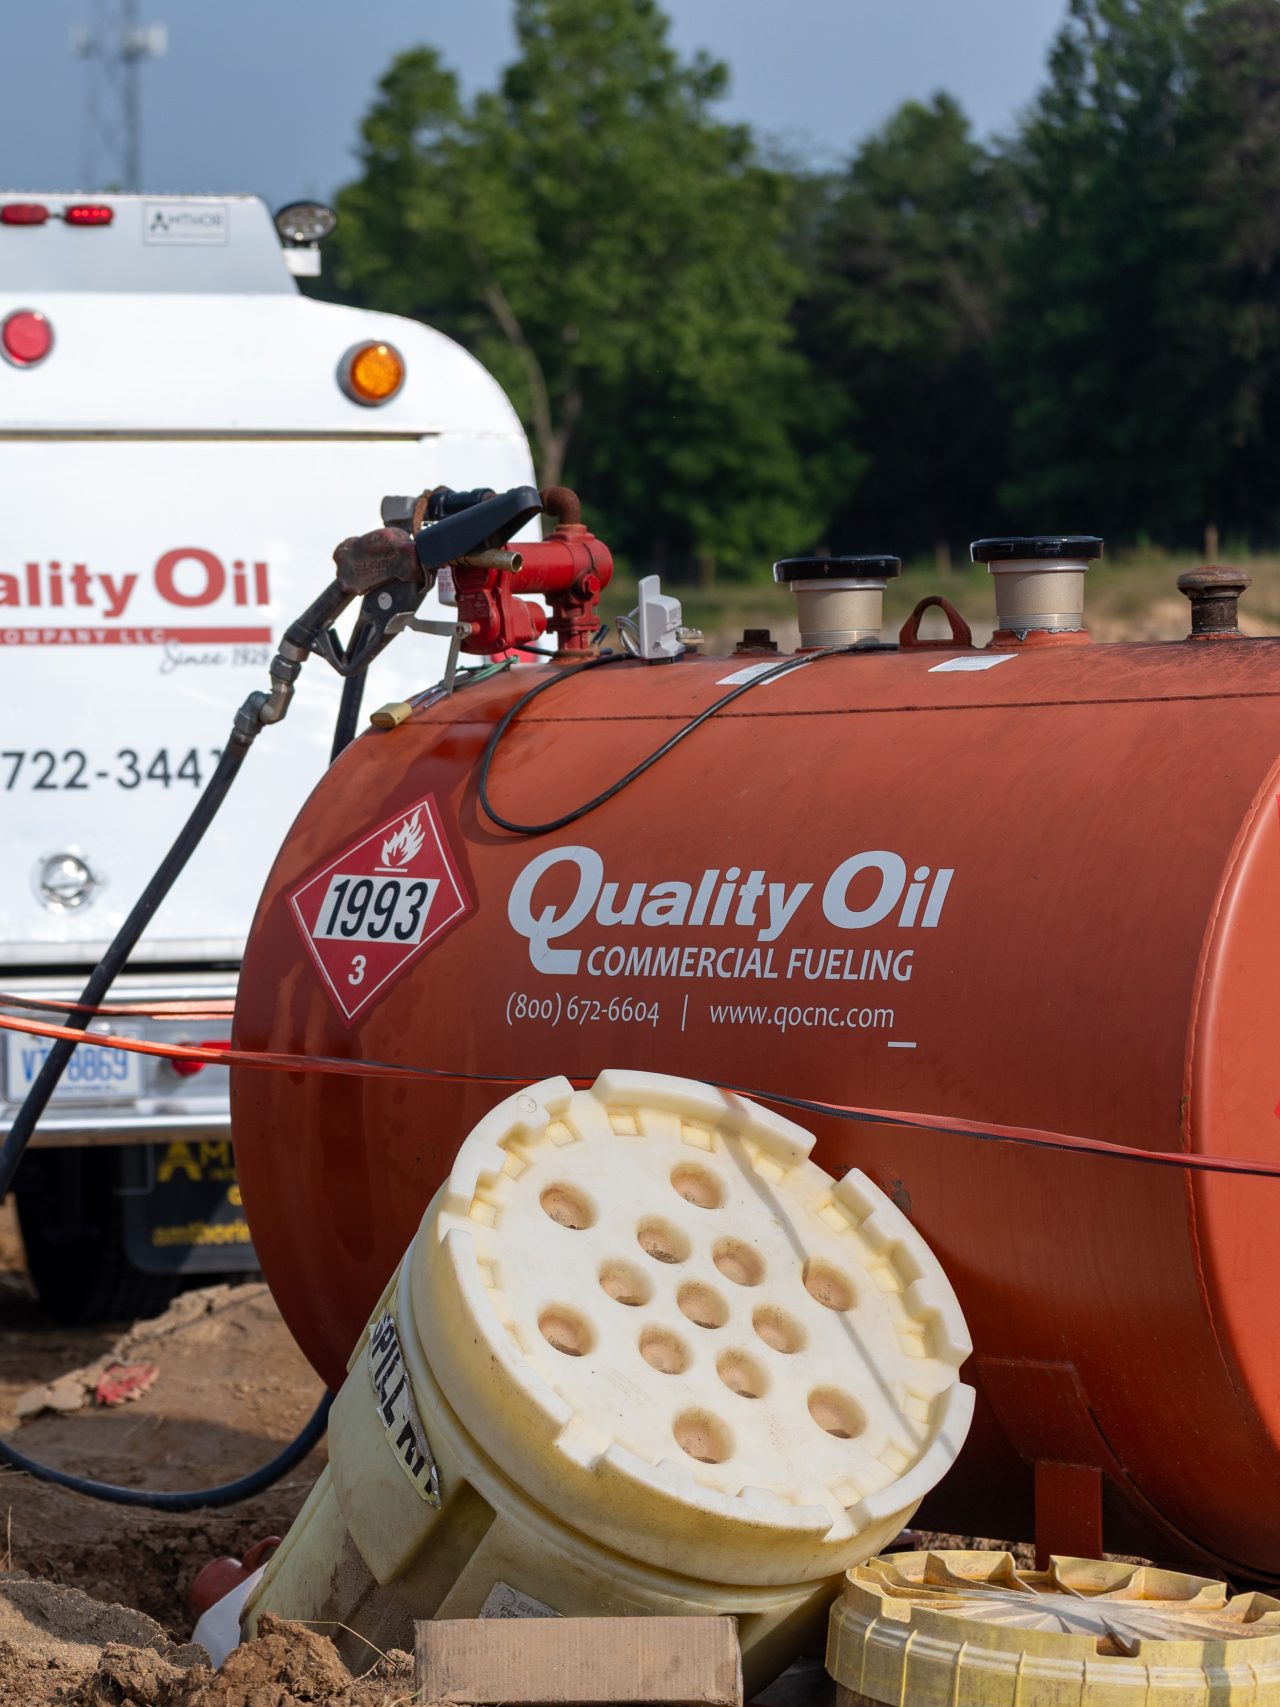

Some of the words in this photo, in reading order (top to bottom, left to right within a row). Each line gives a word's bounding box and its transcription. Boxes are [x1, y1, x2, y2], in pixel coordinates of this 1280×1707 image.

[153, 547, 269, 607] Oil
[120, 627, 167, 644] LLC
[324, 878, 429, 941] 1993
[507, 845, 813, 976] Quality
[821, 850, 956, 929] Oil
[347, 954, 367, 986] 3
[586, 945, 779, 980] COMMERCIAL
[786, 948, 915, 982] FUELING
[505, 991, 563, 1027] (800)
[566, 995, 661, 1028] 672-6604
[709, 1000, 896, 1029] www.qocnc.com
